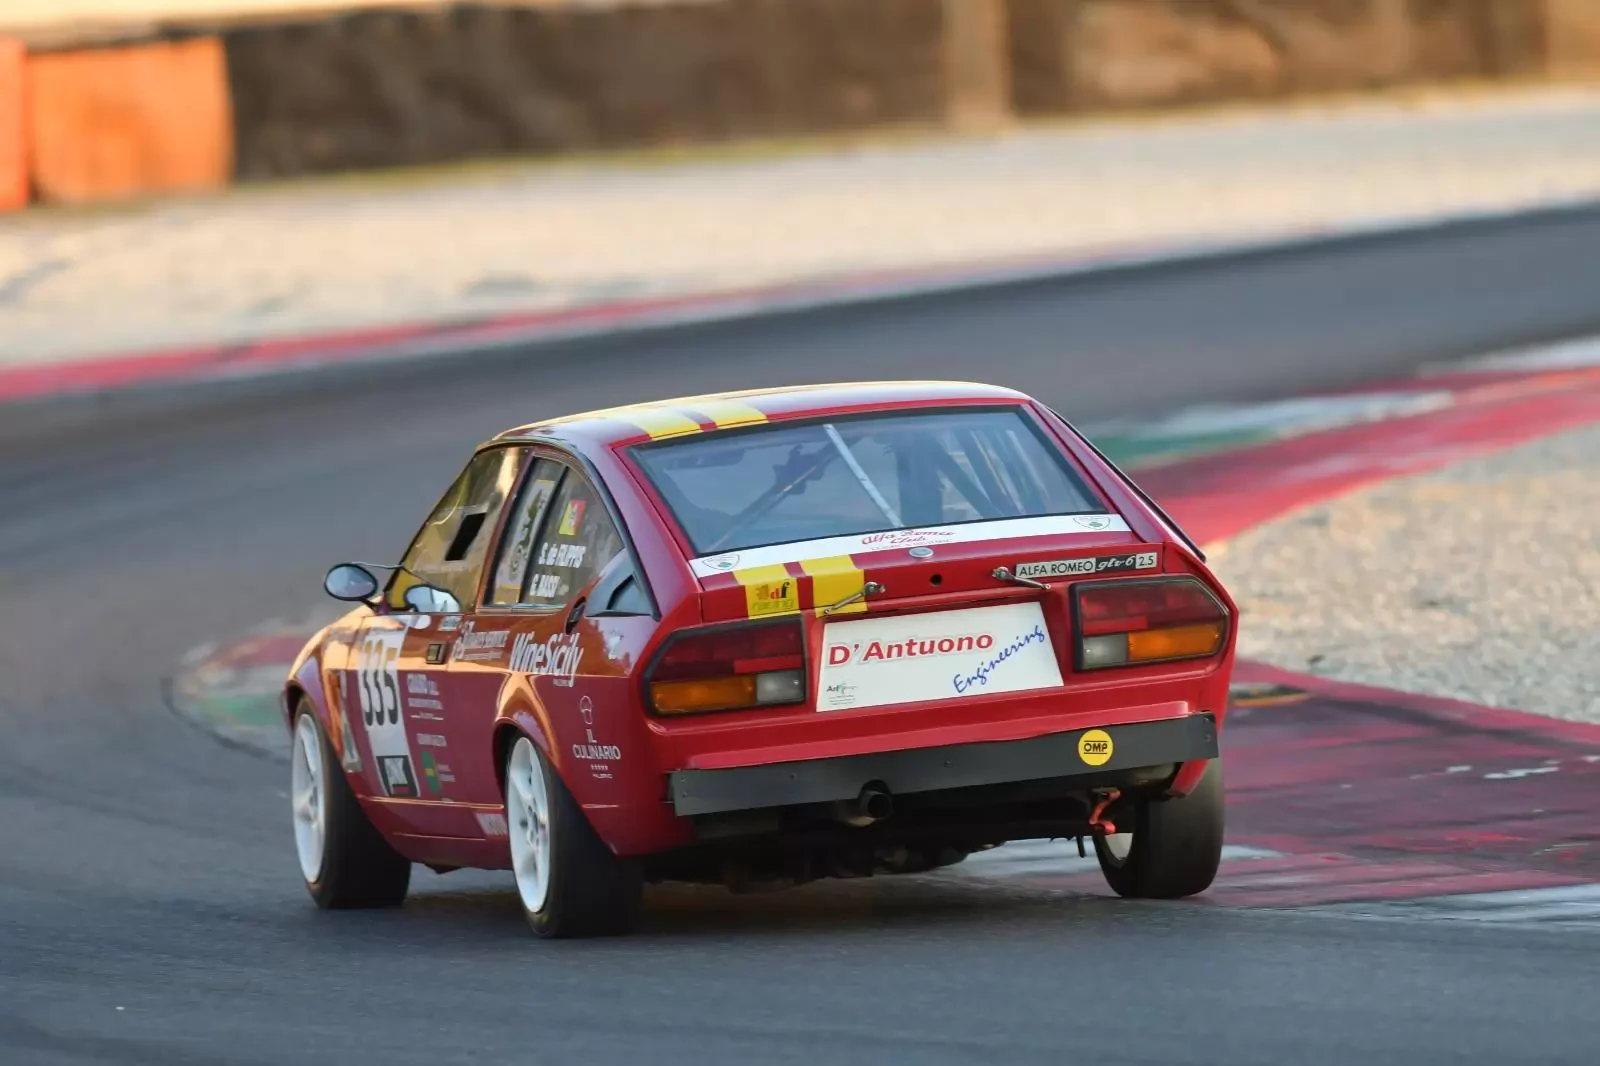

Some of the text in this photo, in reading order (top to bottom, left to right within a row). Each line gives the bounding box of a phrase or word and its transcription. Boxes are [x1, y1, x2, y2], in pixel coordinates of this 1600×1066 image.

[1019, 564, 1048, 577] ALFA
[1051, 560, 1094, 574] ROMEO
[510, 632, 584, 687] WineSicily
[828, 633, 993, 665] D'Antuono
[953, 624, 1046, 694] Engineering
[572, 744, 621, 760] CULINARIO
[1083, 742, 1109, 753] OMP
